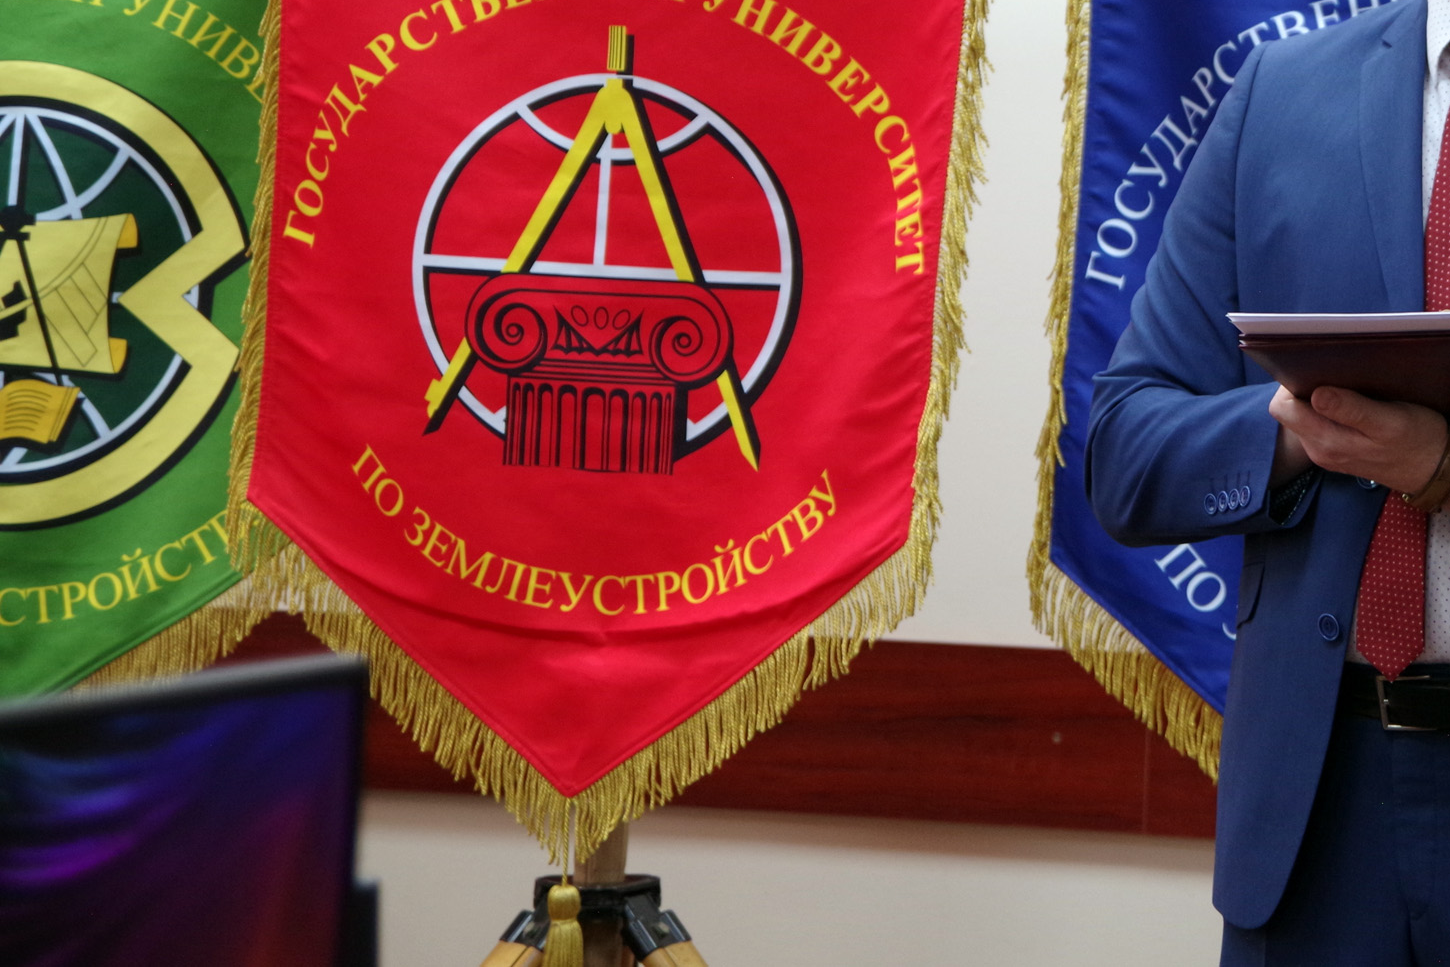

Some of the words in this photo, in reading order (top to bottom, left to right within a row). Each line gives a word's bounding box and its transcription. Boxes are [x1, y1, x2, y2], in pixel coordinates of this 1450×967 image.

[351, 445, 404, 516] ПО
[403, 469, 837, 617] ЗЕМЛЕУСТРОЙСТВУ
[1154, 543, 1227, 612] ПО
